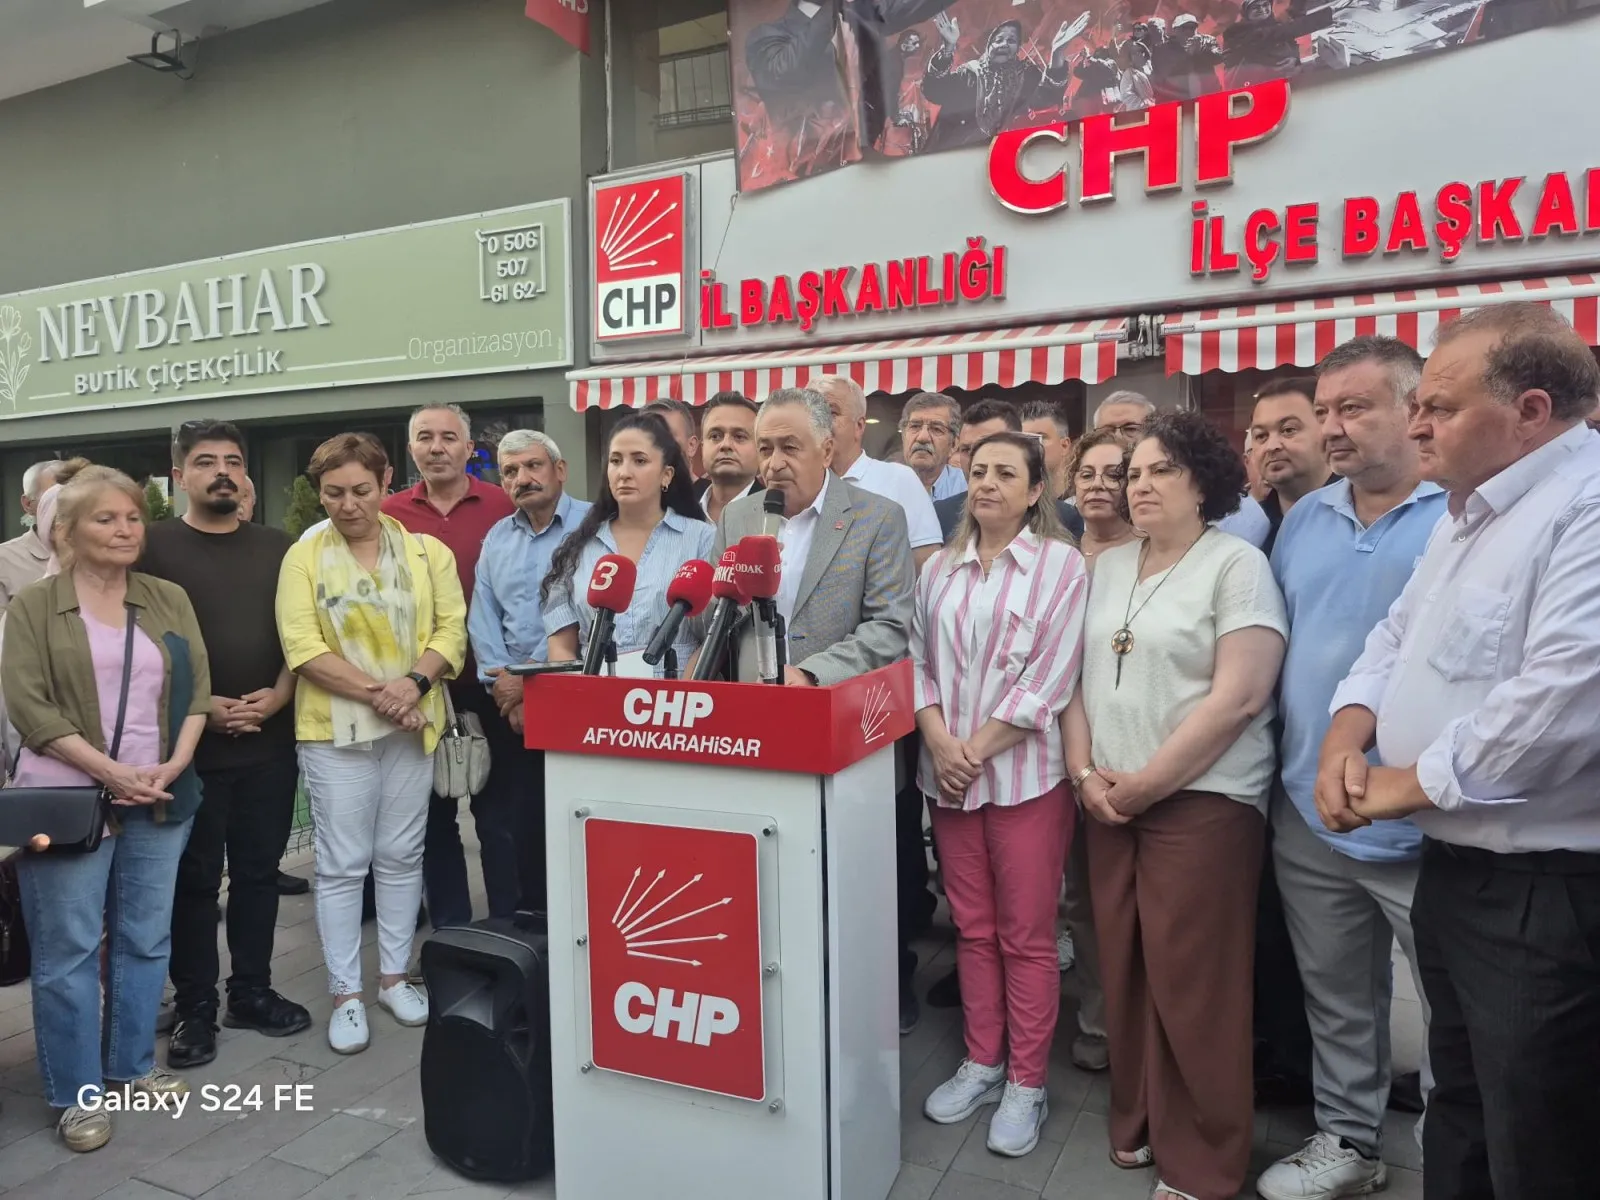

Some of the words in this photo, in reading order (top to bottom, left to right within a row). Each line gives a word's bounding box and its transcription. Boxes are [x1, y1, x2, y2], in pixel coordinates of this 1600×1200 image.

[987, 78, 1291, 214] CHP
[487, 236, 499, 253] 0
[503, 230, 538, 251] 506
[1190, 199, 1319, 284] İLÇE
[497, 256, 529, 277] 507
[700, 268, 736, 330] İL
[741, 236, 1007, 332] BAŞKANLIĞI
[36, 262, 331, 363] NEVBAHAR
[491, 283, 509, 302] 61
[513, 280, 537, 299] 62
[602, 283, 677, 329] CHP
[408, 327, 553, 364] Organizasyon
[74, 364, 140, 395] BUTİK
[146, 346, 284, 392] ÇİÇEKÇİLİK
[590, 561, 619, 590] 3
[735, 563, 764, 574] ODAK
[623, 687, 714, 728] CHP
[613, 981, 741, 1047] CHP
